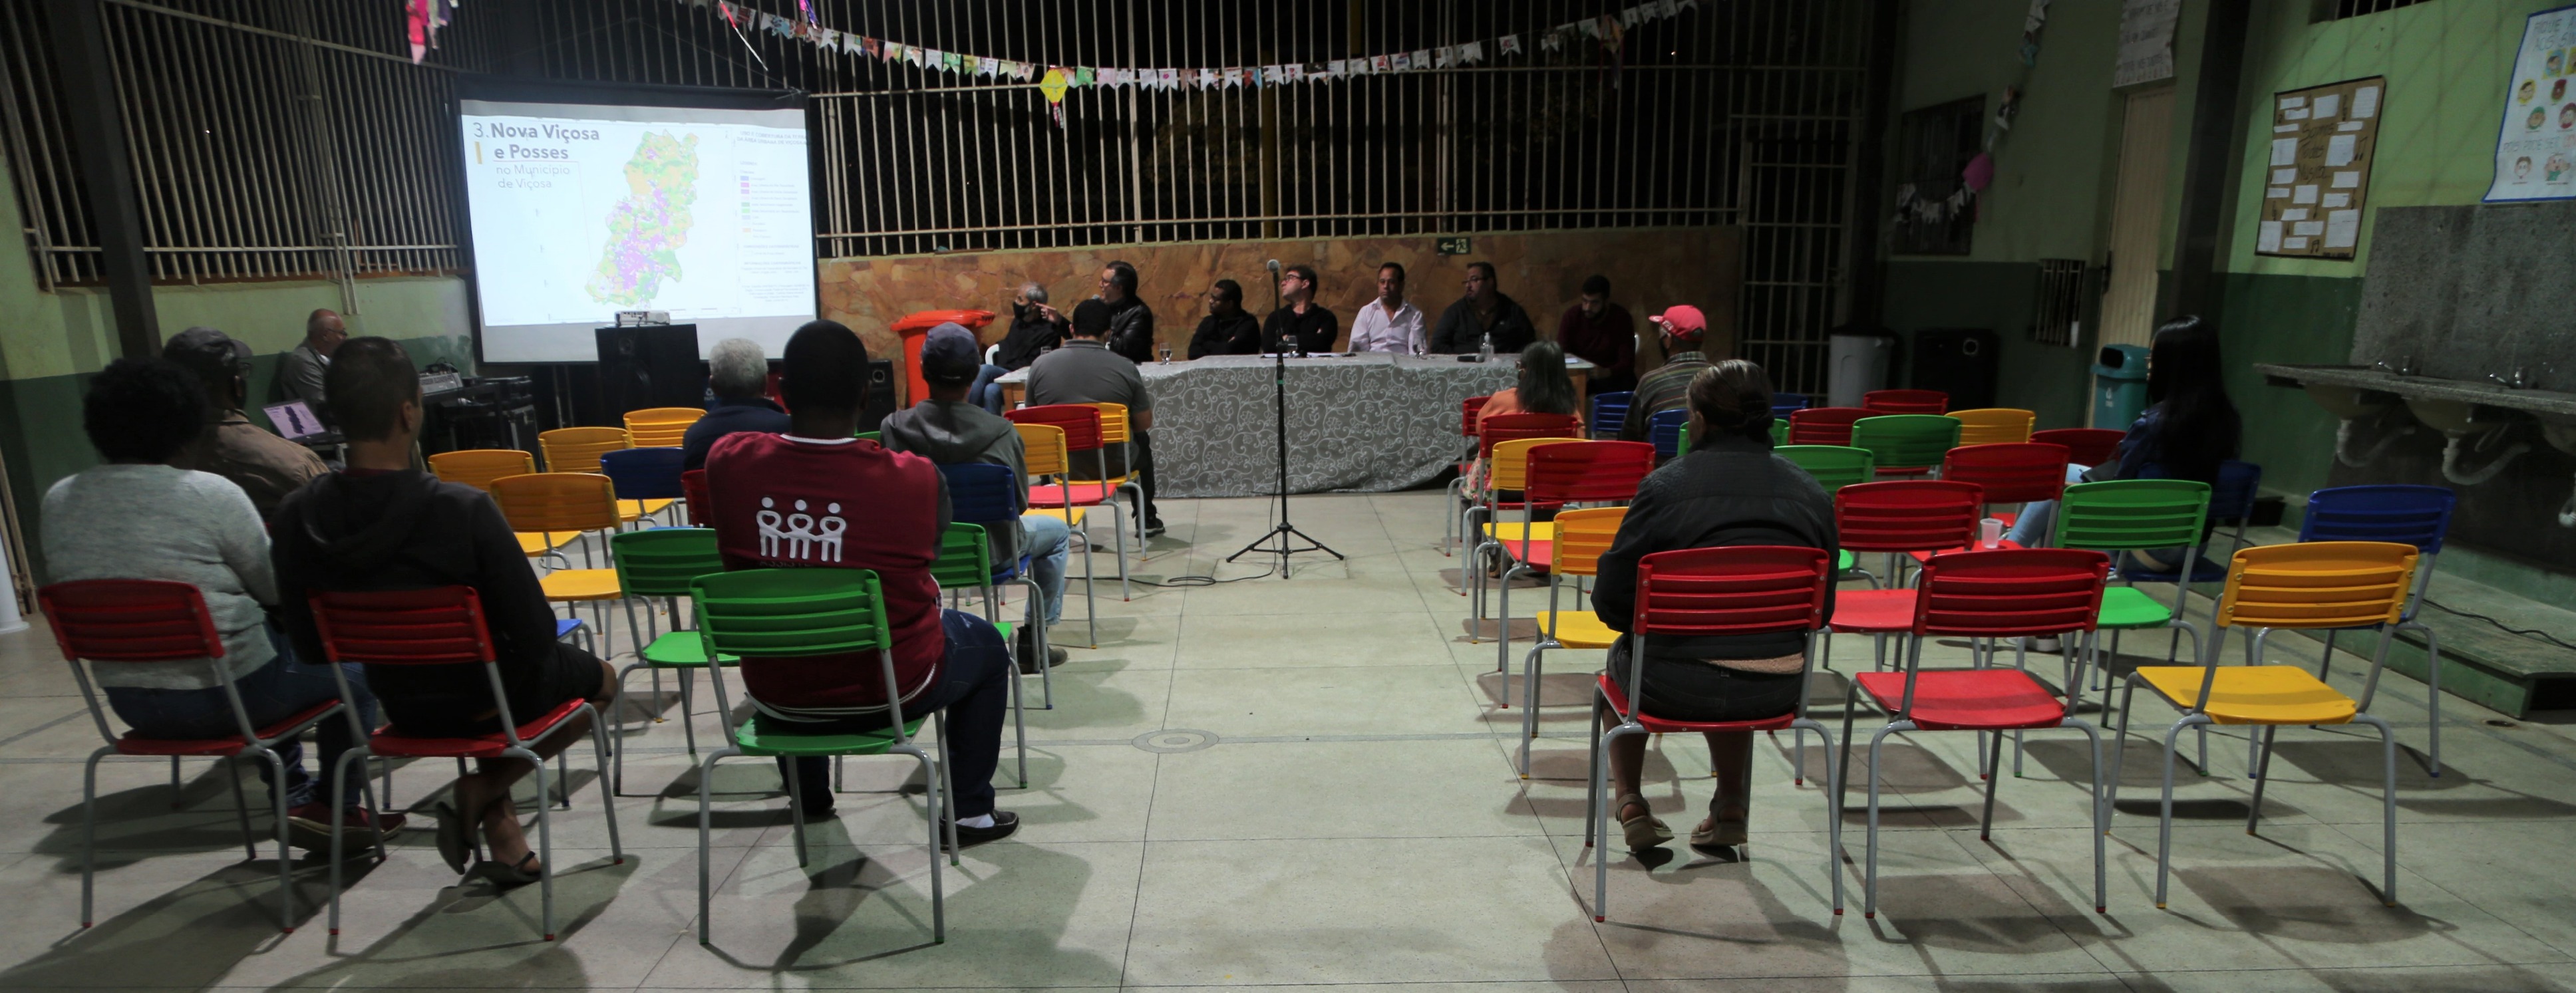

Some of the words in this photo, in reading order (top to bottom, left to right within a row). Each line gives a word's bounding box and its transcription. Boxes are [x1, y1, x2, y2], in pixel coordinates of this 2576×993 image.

[542, 124, 600, 144] Viçosa
[494, 148, 505, 159] e
[509, 144, 569, 159] Posses
[496, 166, 511, 175] no
[498, 178, 514, 189] de
[516, 178, 552, 191] Viçosa
